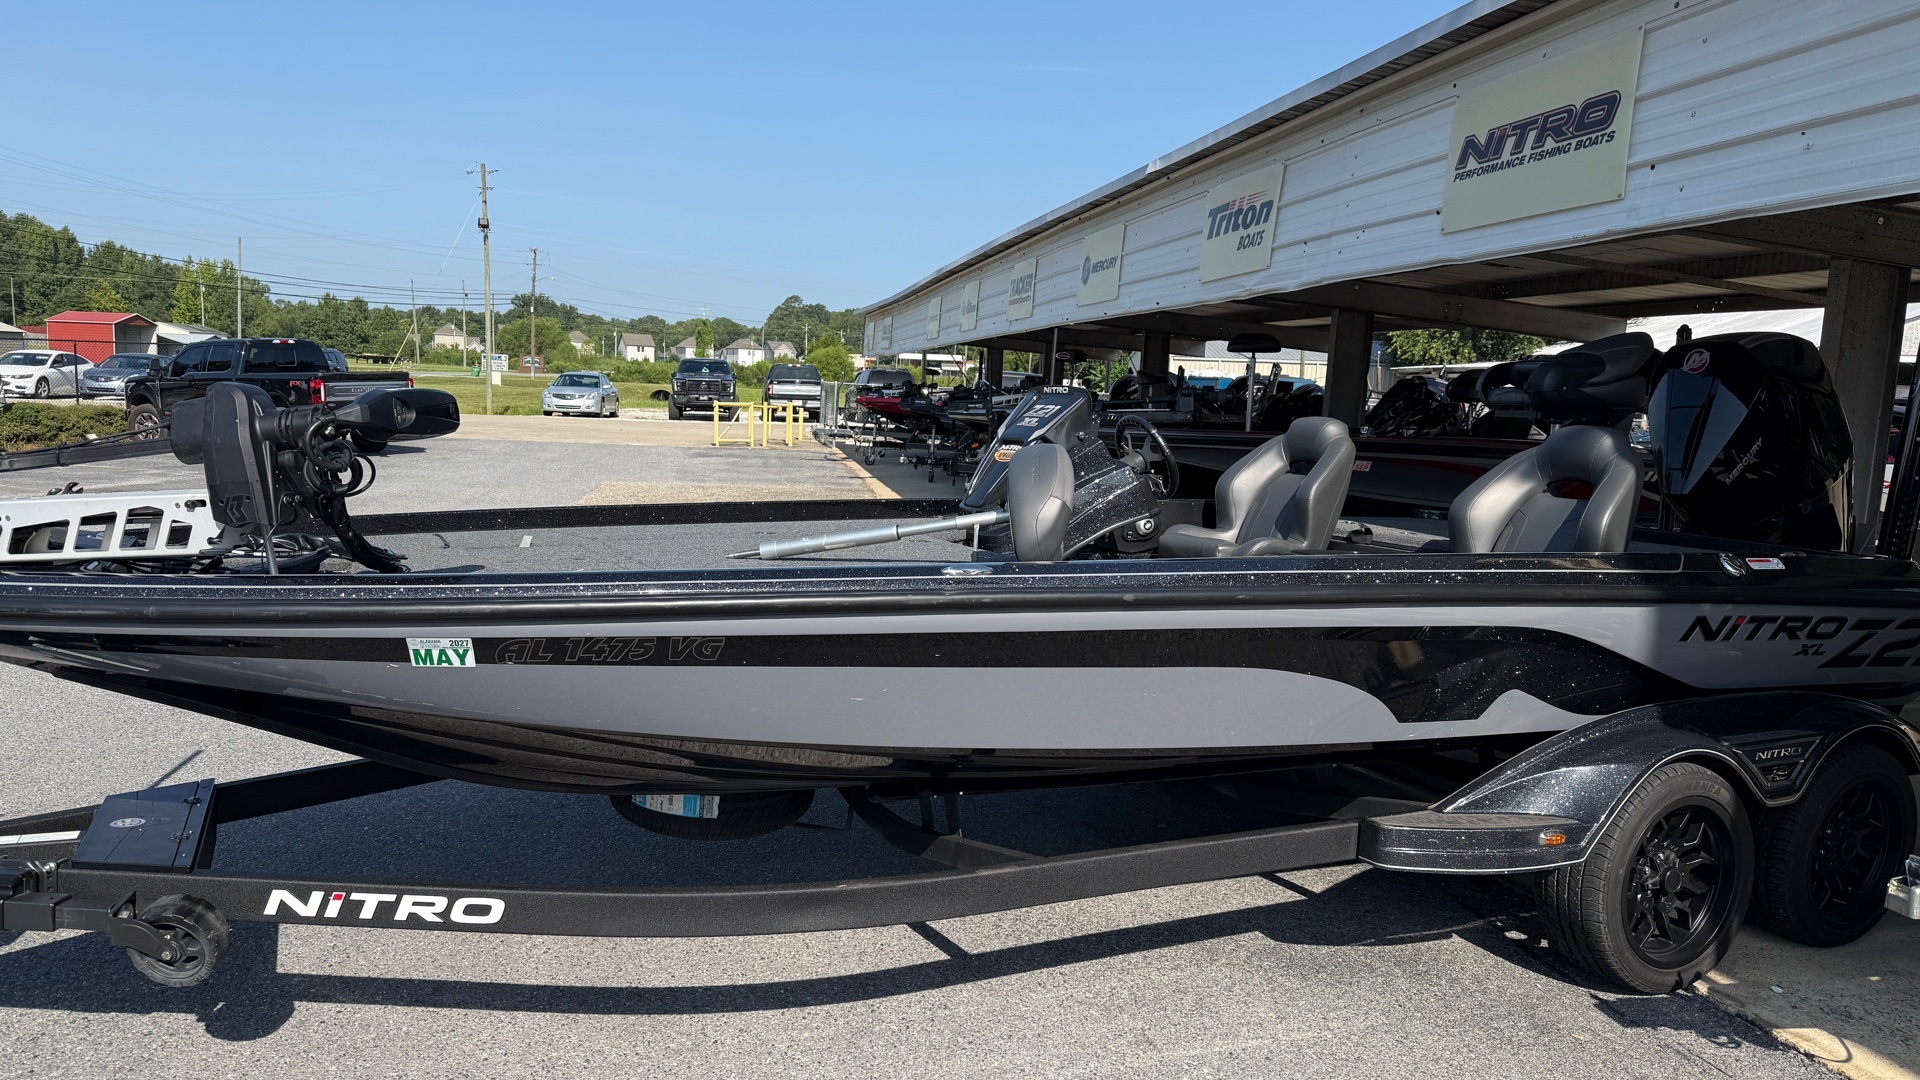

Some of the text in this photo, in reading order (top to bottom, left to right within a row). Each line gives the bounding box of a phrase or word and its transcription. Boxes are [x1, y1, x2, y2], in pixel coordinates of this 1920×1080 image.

[1453, 131, 1616, 182] PERFORMANCE FISHING BOATS
[1207, 200, 1274, 240] Triton
[1237, 229, 1265, 251] BOATS
[1091, 255, 1119, 274] MERCURY
[1725, 437, 1763, 486] MERCURY
[448, 639, 469, 647] 2027
[495, 636, 725, 664] AL 1475 VG
[1792, 643, 1826, 657] XL
[1817, 616, 1920, 669] Z2
[412, 648, 470, 666] MAY
[1755, 747, 1802, 761] NITRO
[1685, 780, 1722, 797] KENDA
